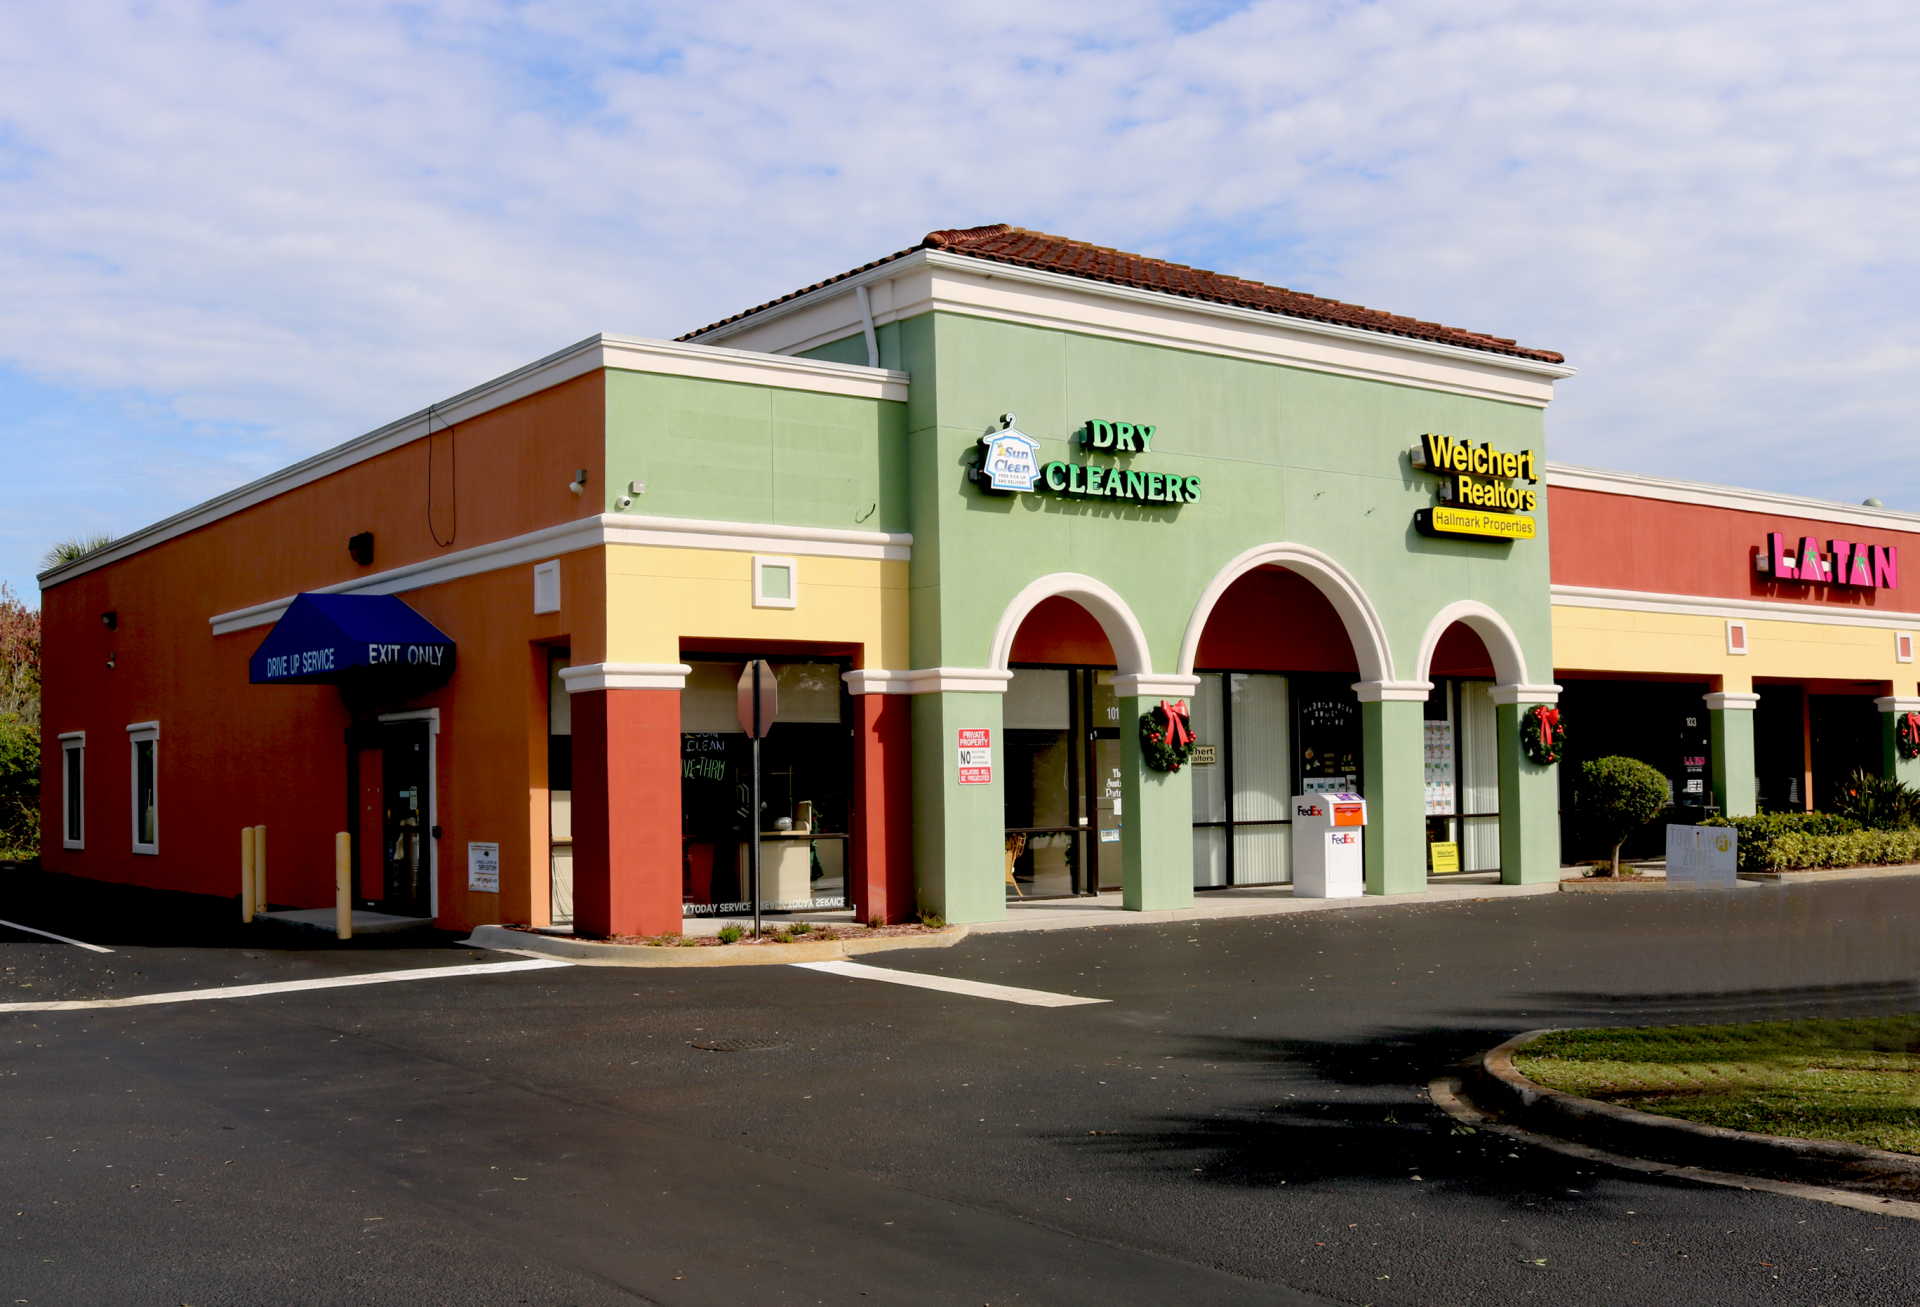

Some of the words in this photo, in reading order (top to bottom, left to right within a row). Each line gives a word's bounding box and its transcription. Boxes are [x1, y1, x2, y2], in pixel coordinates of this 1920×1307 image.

[1091, 419, 1156, 453] DRY
[1005, 447, 1029, 459] Sun
[995, 459, 1030, 473] Clean
[1045, 461, 1202, 504] CLEANERS
[1459, 475, 1537, 511] Realtors
[1436, 511, 1480, 528] Hallmark
[1483, 516, 1533, 533] Properties
[369, 643, 401, 665] EXIT
[407, 645, 444, 666] ONLY
[267, 656, 287, 677] DRIVE
[290, 654, 300, 675] UP
[302, 648, 335, 673] SERVICE
[1106, 707, 1120, 720] 101
[1686, 717, 1697, 727] 103
[963, 731, 985, 739] PRIVATE
[687, 740, 725, 752] CLEAN
[961, 750, 971, 765] NO
[1297, 805, 1323, 816] FedEx
[1332, 833, 1355, 845] FedEx
[1669, 828, 1694, 848] TOW
[1683, 848, 1716, 868] ZONE
[689, 903, 718, 914] TODAY
[719, 902, 752, 912] SERVICE
